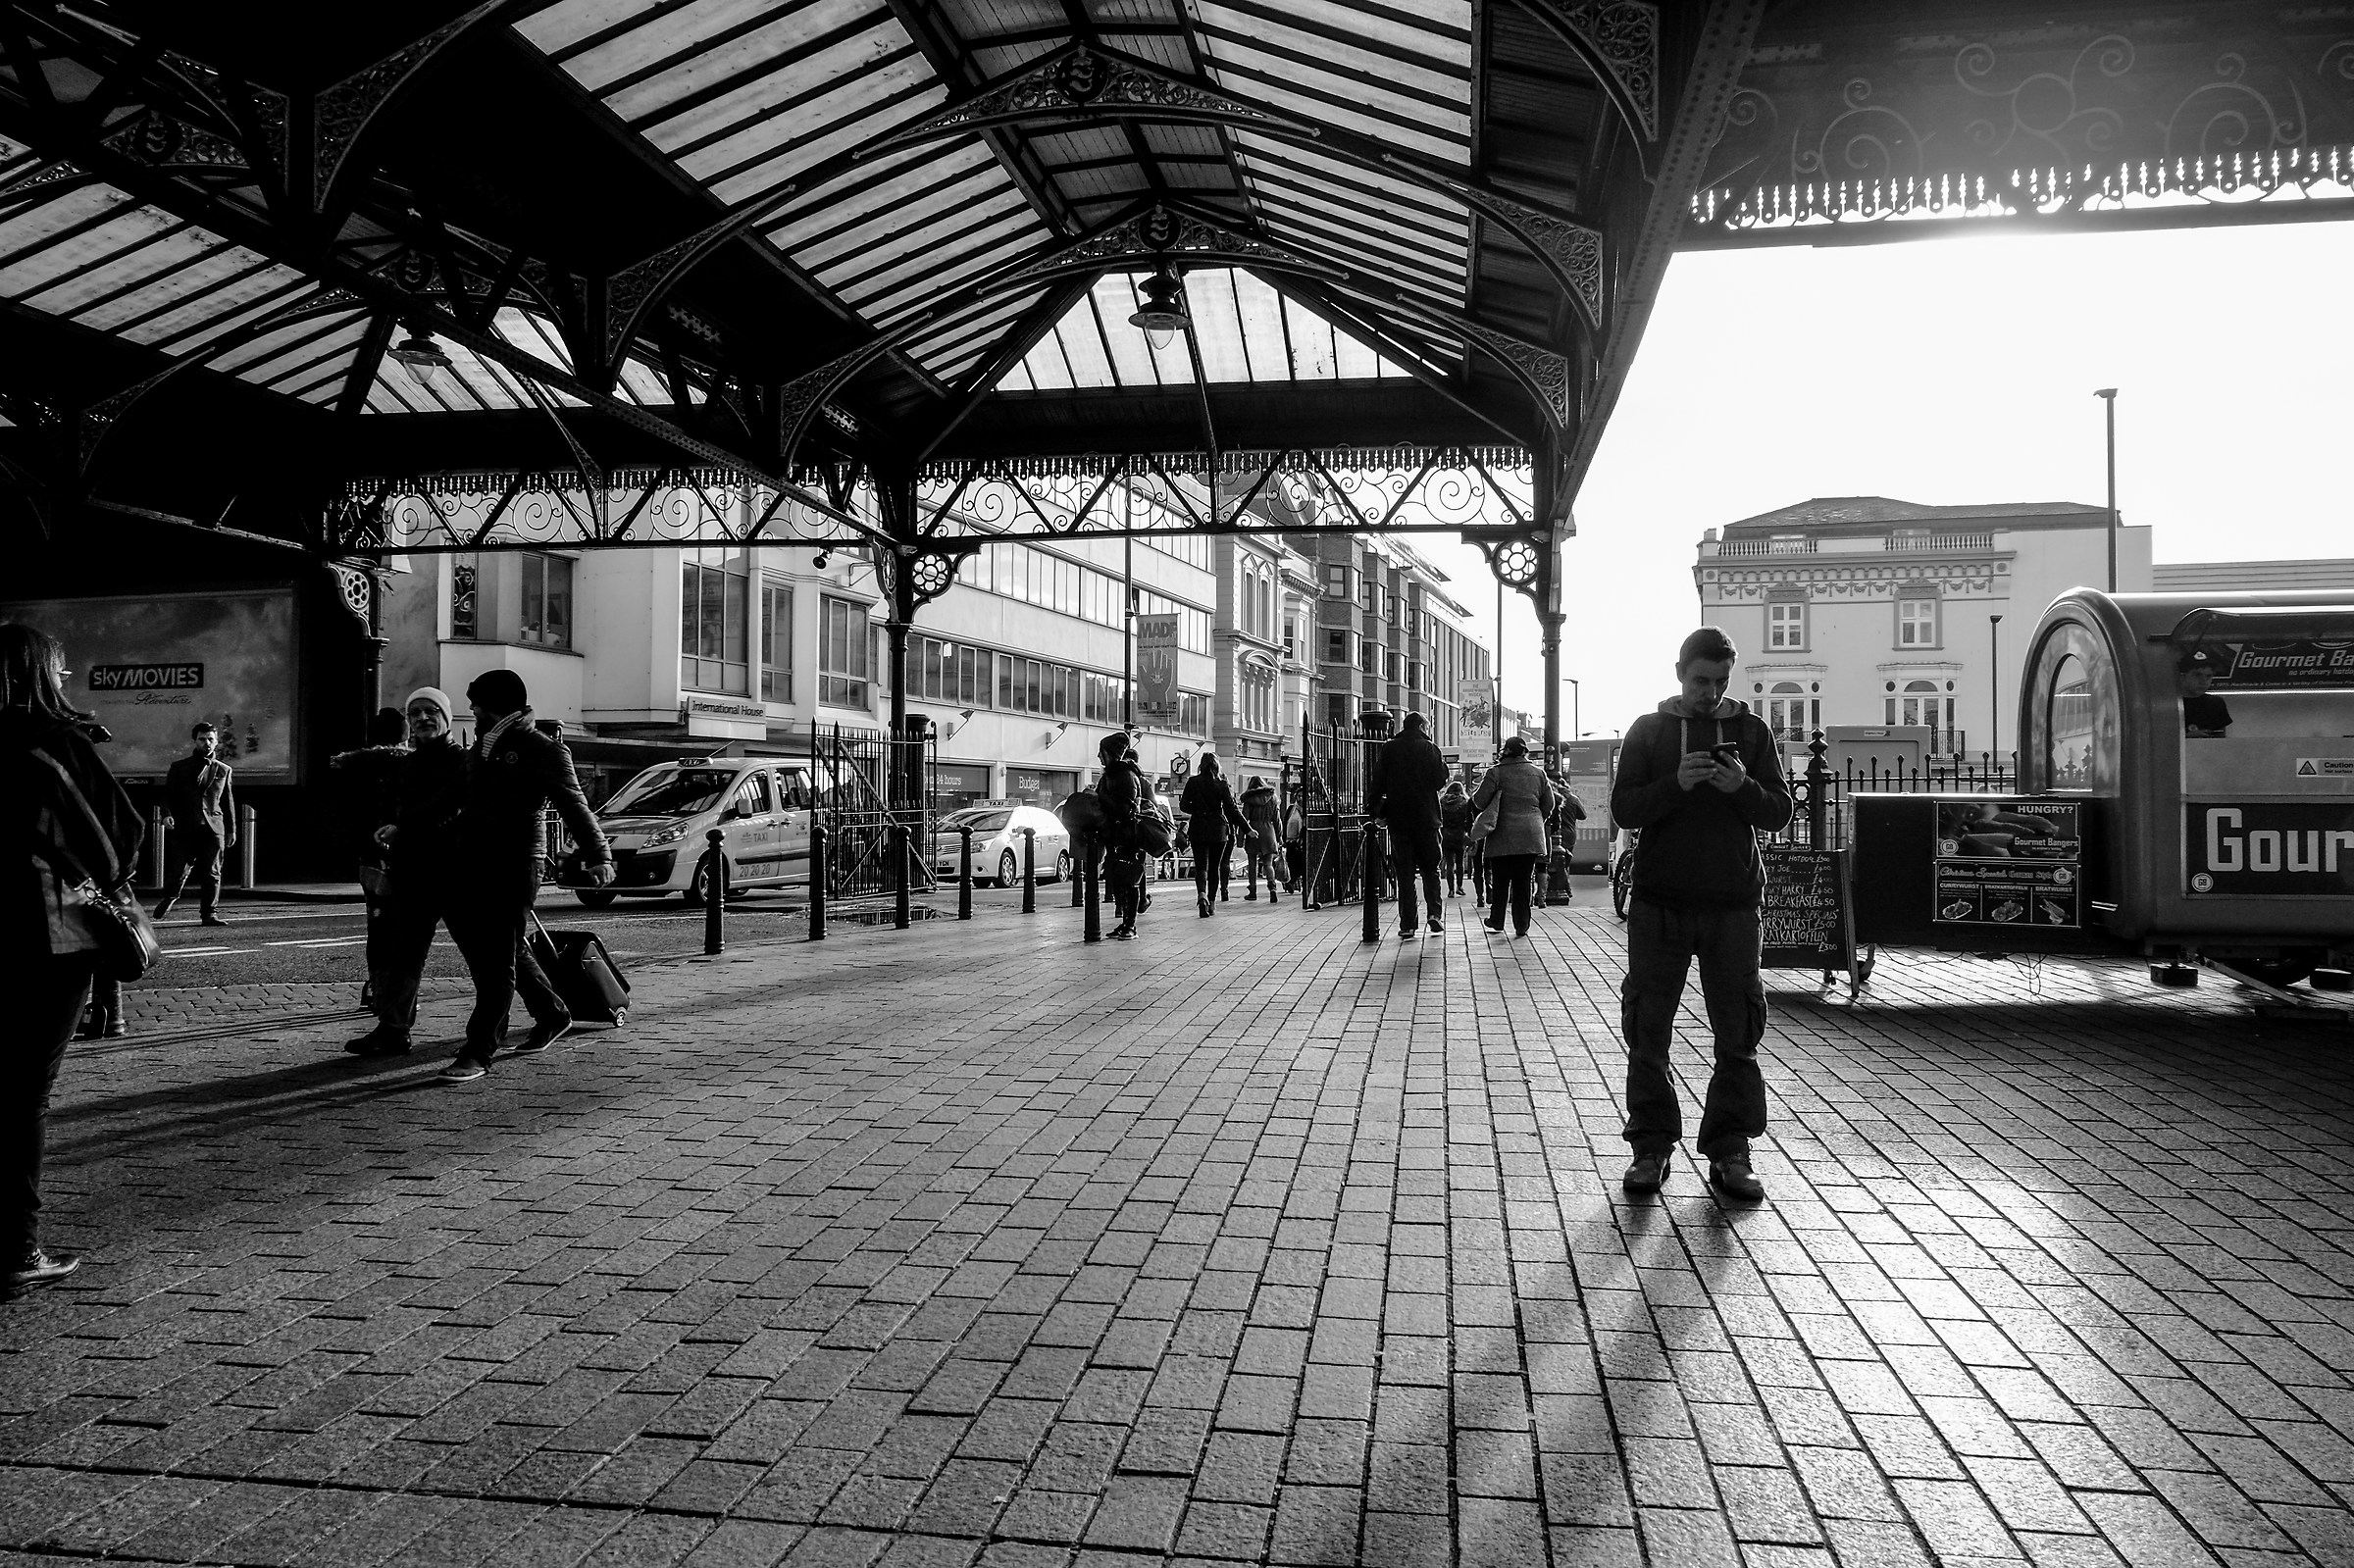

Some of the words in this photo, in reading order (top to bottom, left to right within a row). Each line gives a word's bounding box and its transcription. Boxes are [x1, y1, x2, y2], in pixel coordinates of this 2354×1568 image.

[2237, 651, 2327, 669] Gourmet
[93, 668, 122, 688] sky
[122, 667, 201, 687] MOVIES
[691, 700, 741, 715] International
[742, 705, 764, 717] House
[945, 775, 962, 786] hours
[2018, 805, 2074, 814] HUNGRY?
[753, 833, 769, 843] TAXI
[2014, 836, 2047, 846] Gourmet
[2047, 837, 2079, 849] Bangers
[2206, 807, 2354, 873] Gour
[739, 866, 749, 878] 20
[750, 865, 760, 877] 20
[760, 864, 771, 875] 20
[1776, 864, 1791, 873] JOE
[1781, 885, 1805, 895] HARRY
[1767, 894, 1814, 908] BREAKFAST
